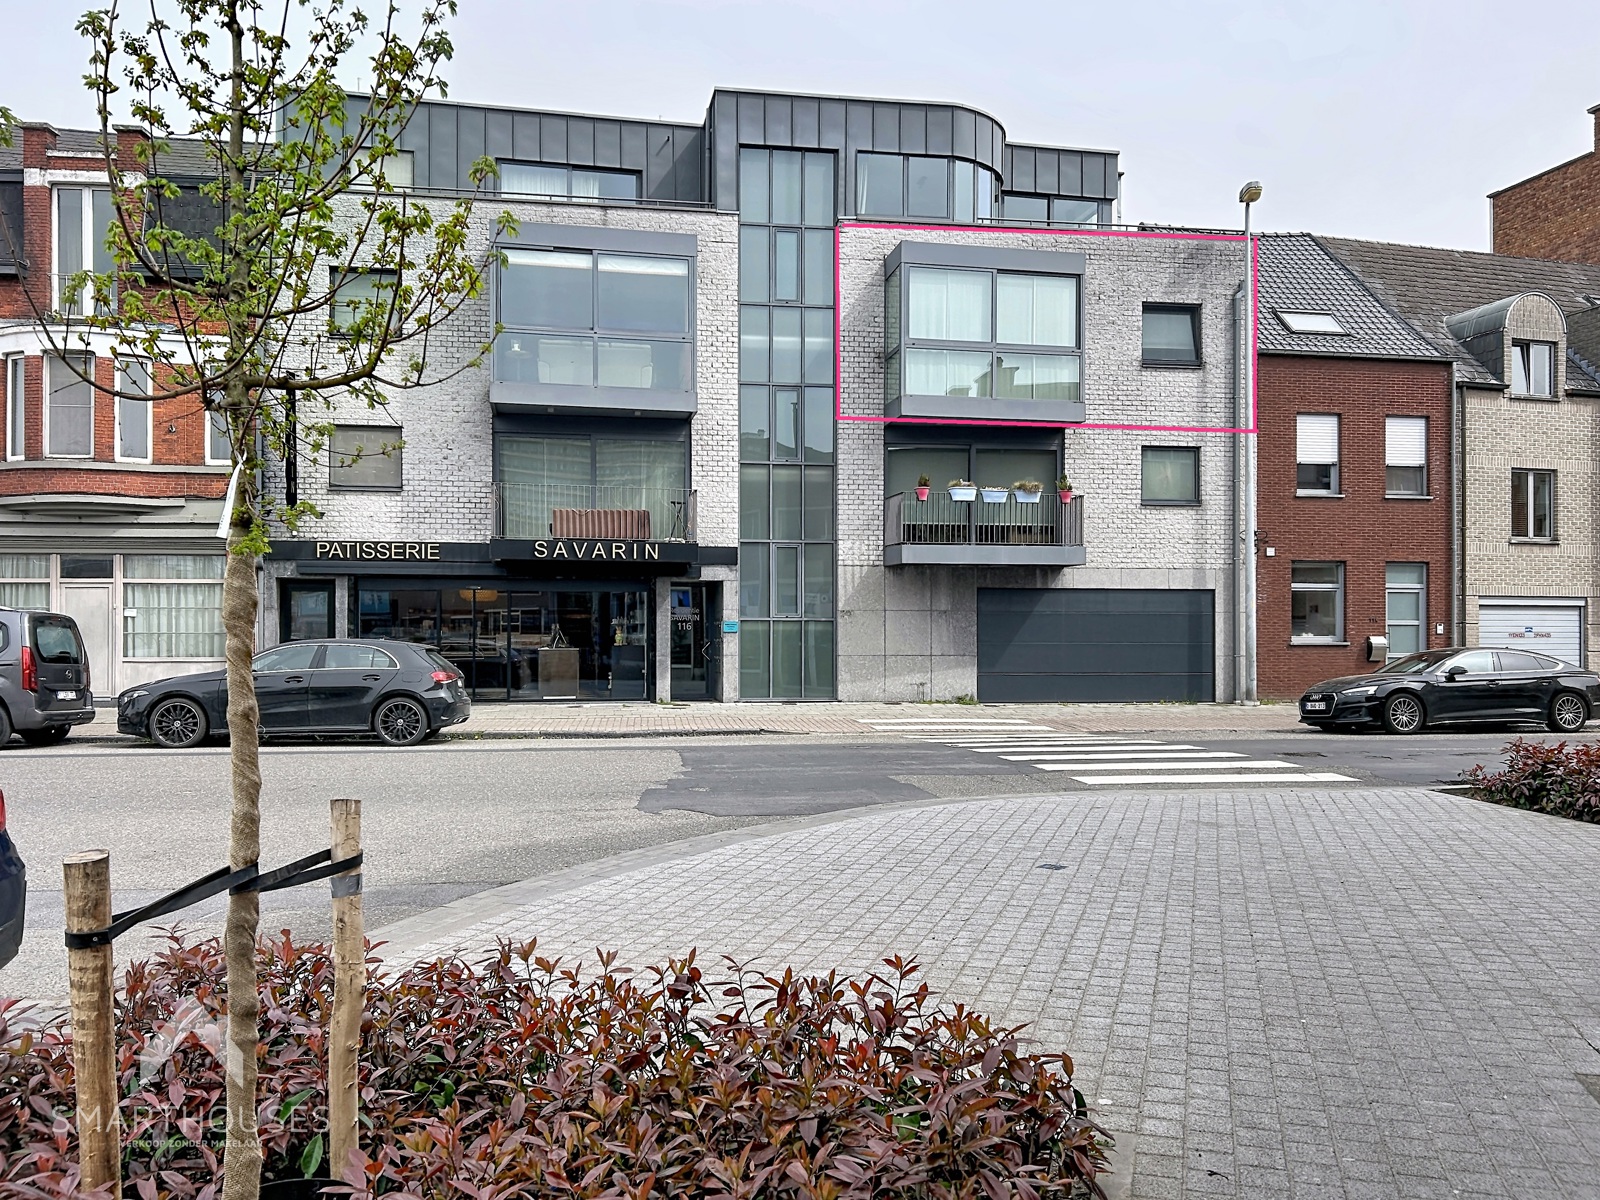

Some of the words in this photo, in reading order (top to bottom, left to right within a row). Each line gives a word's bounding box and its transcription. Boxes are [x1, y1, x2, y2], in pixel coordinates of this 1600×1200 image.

[316, 542, 441, 560] PATISSERIE
[534, 541, 659, 560] SAVARIN
[677, 622, 692, 630] 116
